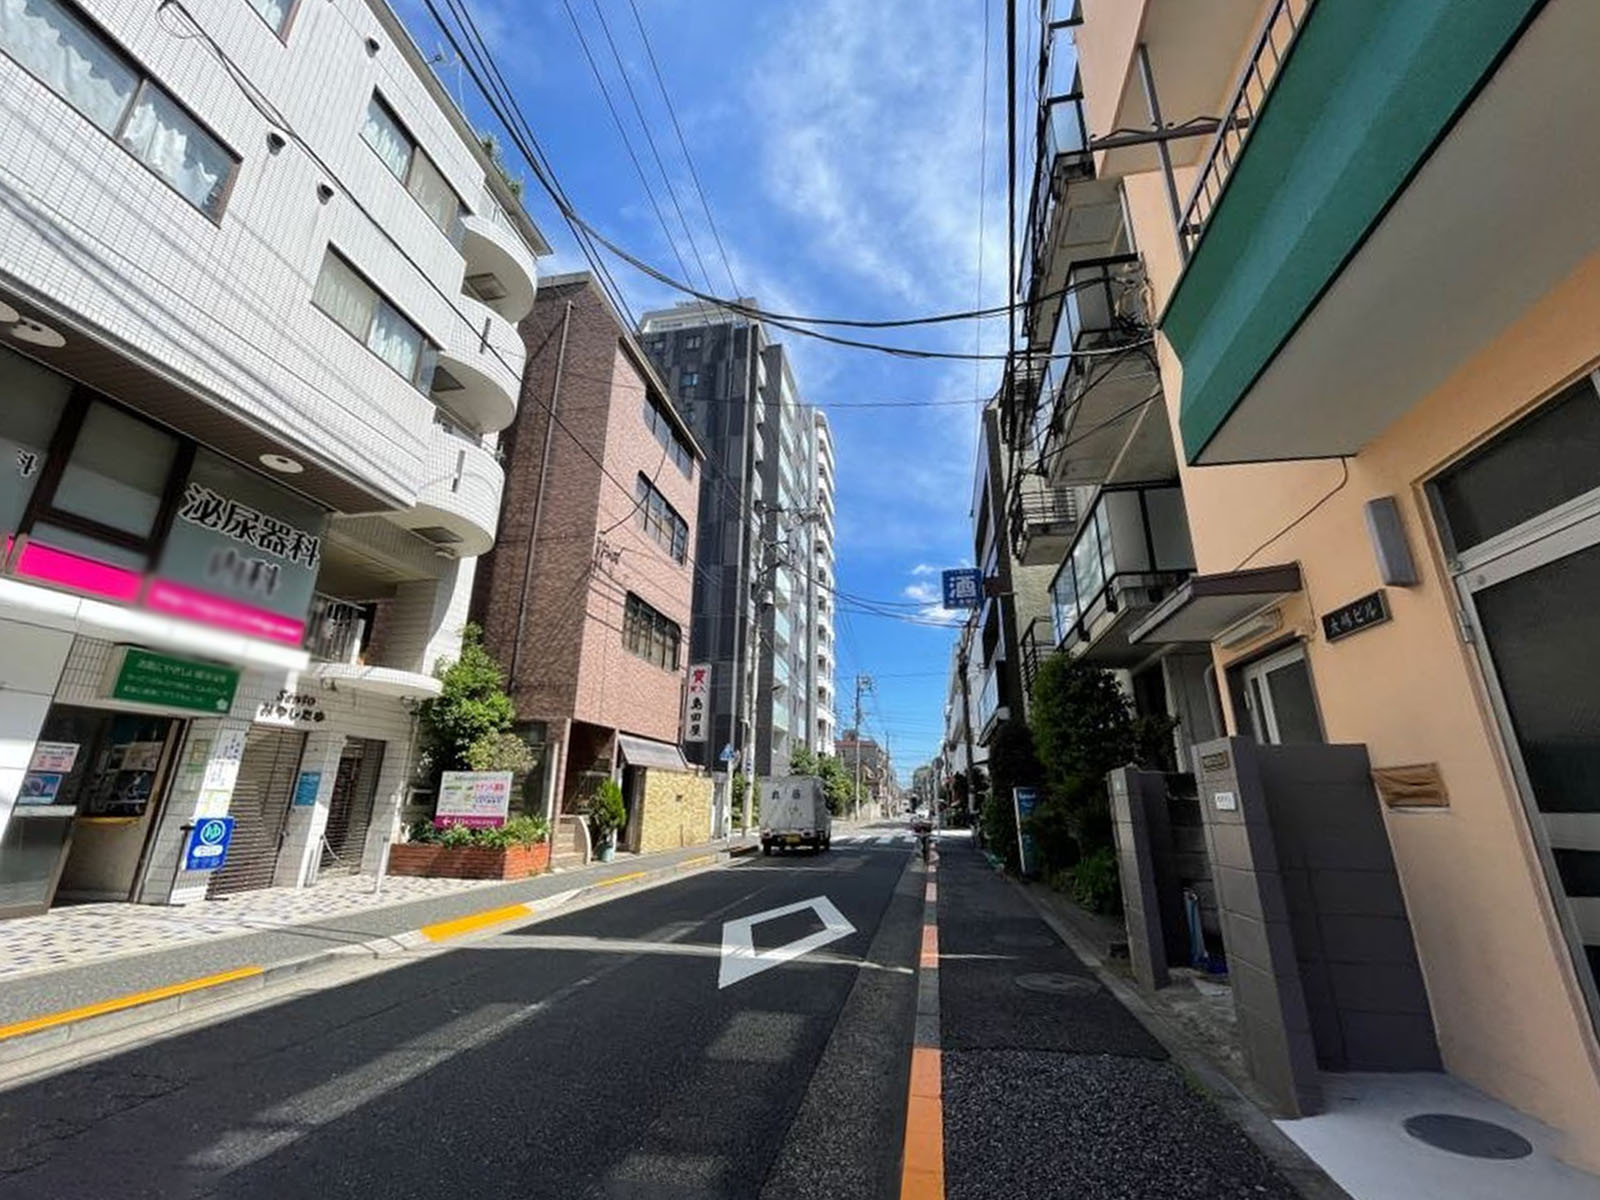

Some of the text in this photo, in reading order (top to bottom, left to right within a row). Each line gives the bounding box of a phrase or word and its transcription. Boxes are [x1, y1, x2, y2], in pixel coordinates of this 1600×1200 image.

[180, 484, 320, 568] 泌尿器科
[949, 576, 977, 598] 酒
